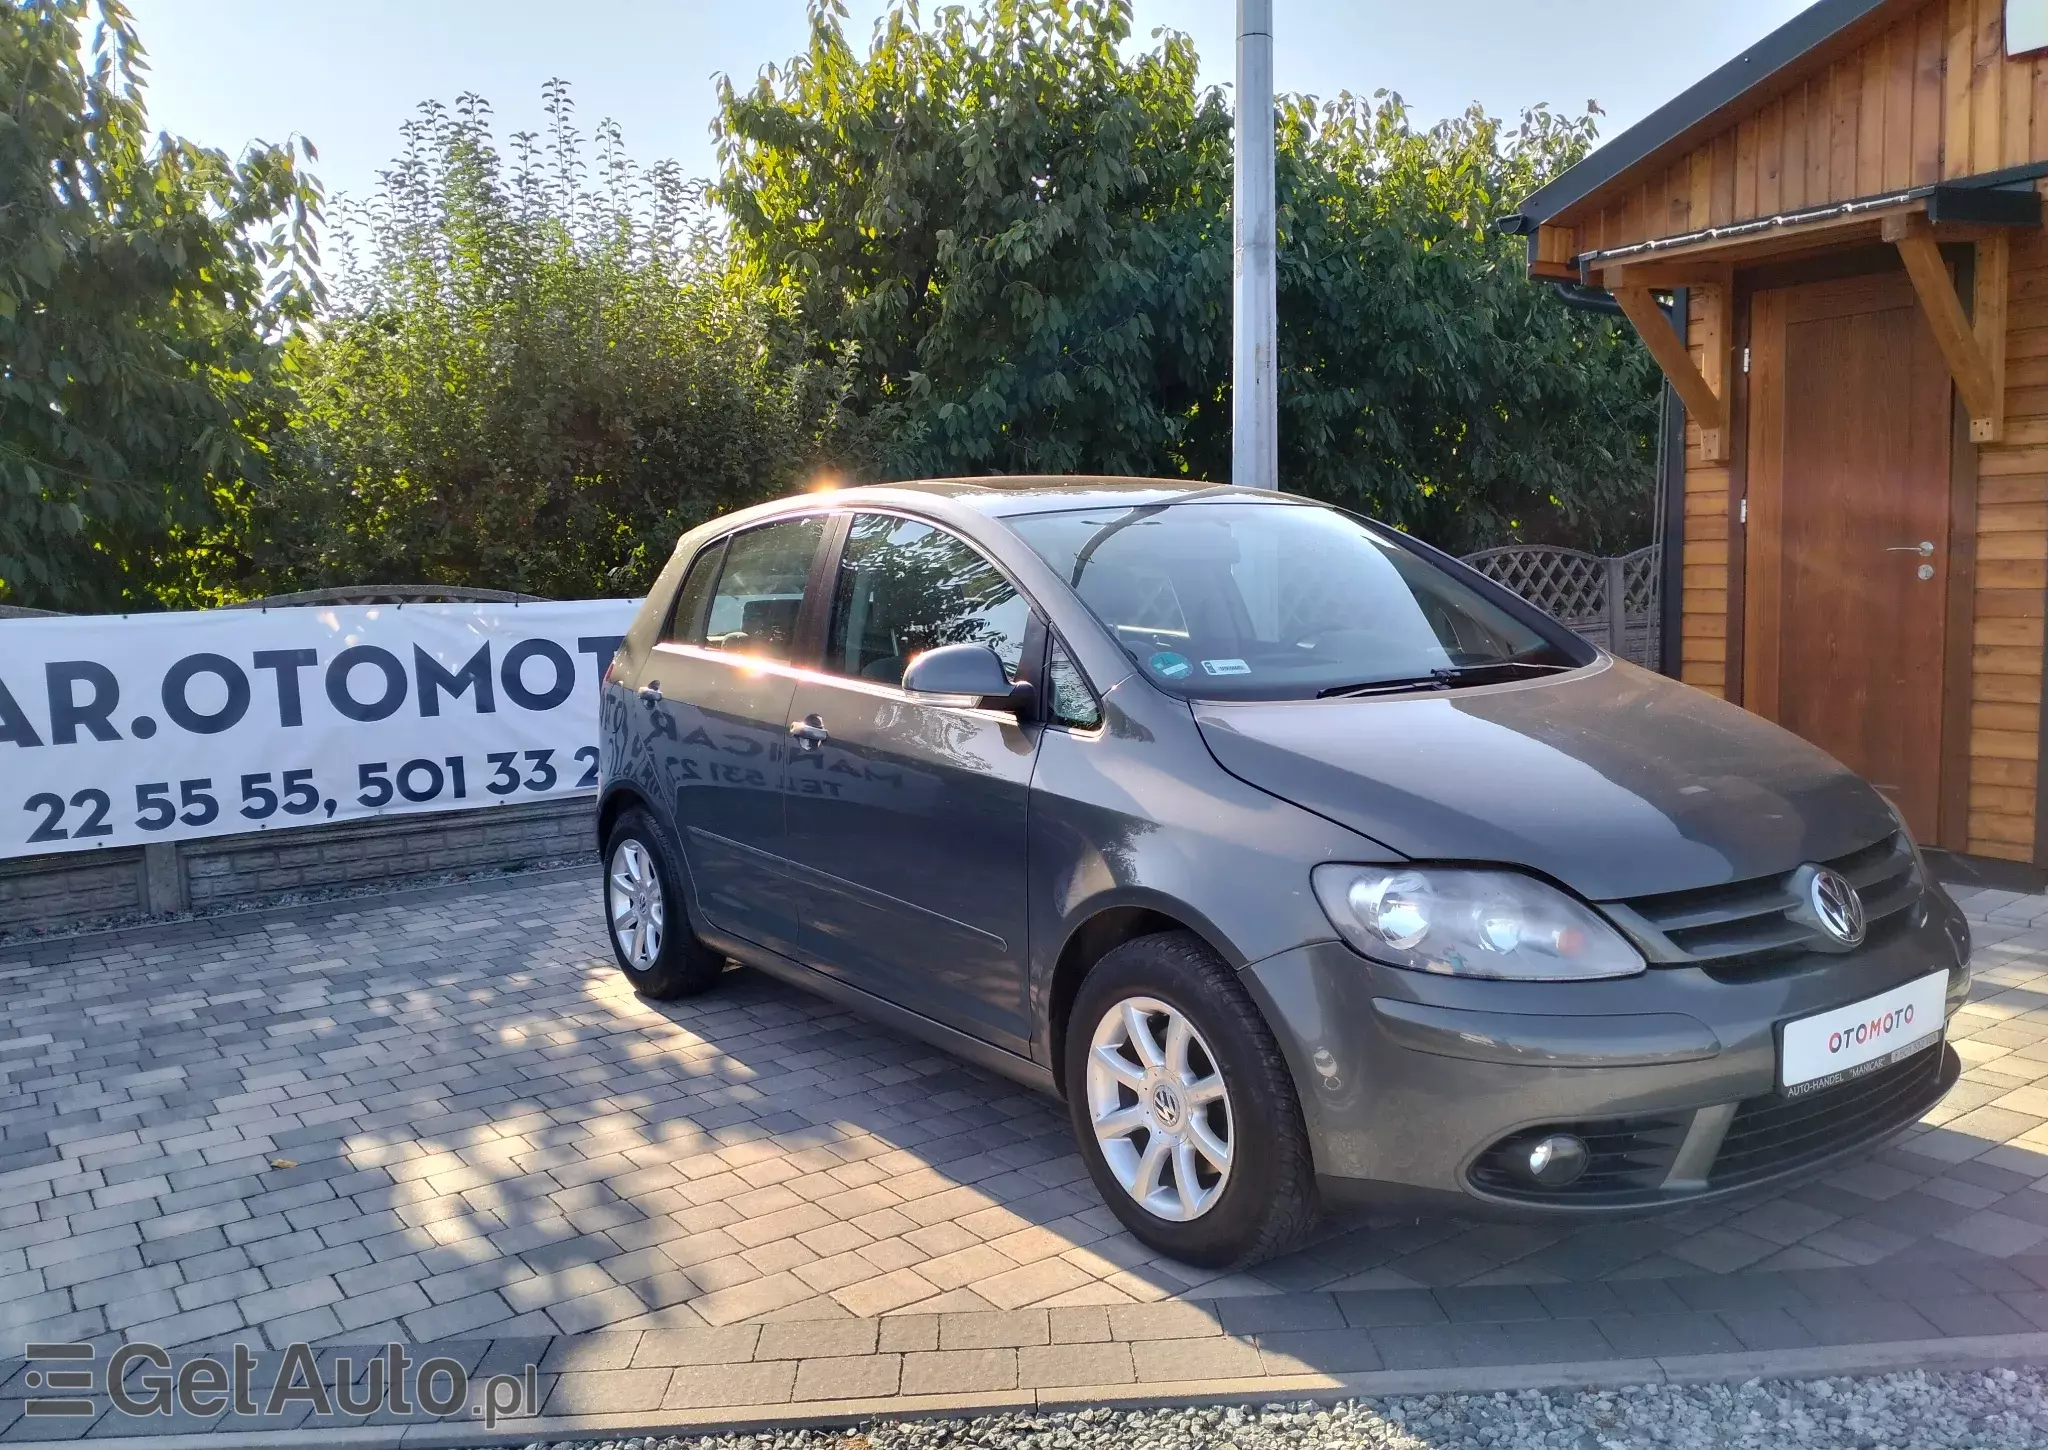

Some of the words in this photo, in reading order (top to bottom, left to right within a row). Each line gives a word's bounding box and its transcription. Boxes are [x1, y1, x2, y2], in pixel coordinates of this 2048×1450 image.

[23, 789, 113, 843] 22
[135, 778, 219, 831] 55
[240, 769, 337, 818] 55,
[357, 756, 466, 808] 501
[486, 749, 557, 795] 33
[1828, 1004, 1914, 1054] OTOMOTO
[1788, 1073, 1844, 1098] AUTO-HANDEL
